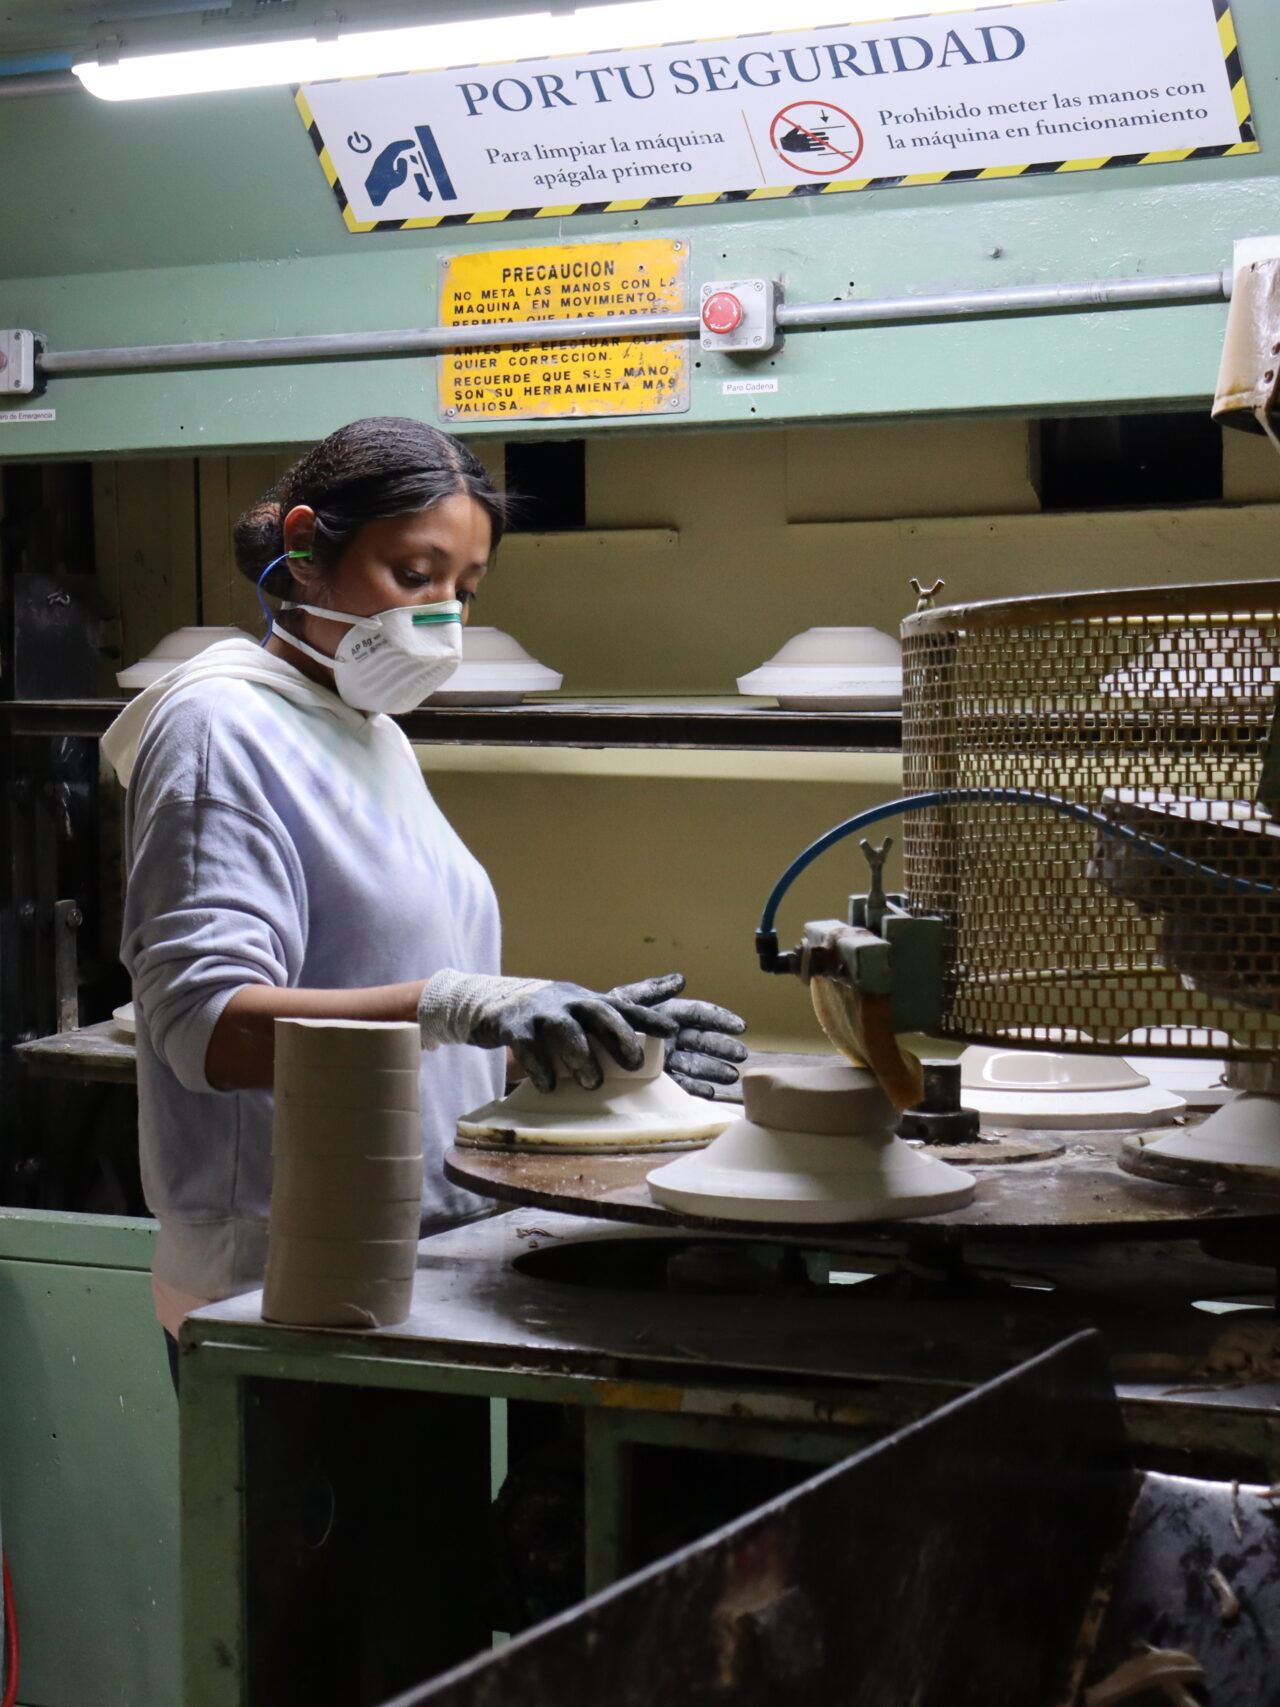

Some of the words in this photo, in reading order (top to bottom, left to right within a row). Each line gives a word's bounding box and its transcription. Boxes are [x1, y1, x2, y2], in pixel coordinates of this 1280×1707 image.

[455, 74, 578, 117] POR
[575, 63, 655, 104] TU
[668, 24, 1026, 95] SEGURIDAD
[878, 101, 982, 127] Prohibido
[987, 97, 1049, 117] meter
[1052, 91, 1083, 110] las
[1087, 87, 1160, 106] manos
[1165, 80, 1206, 98] con
[887, 133, 907, 150] la
[911, 124, 1001, 151] máquina
[1006, 124, 1030, 139] en
[1035, 105, 1208, 136] funcionamiento
[485, 146, 533, 165] Para
[536, 137, 607, 163] limpiar
[610, 136, 630, 153] la
[635, 127, 725, 153] máquina
[533, 163, 607, 190] apágala
[612, 158, 693, 183] primero
[502, 260, 614, 283] PRECAUCION
[454, 291, 472, 301] NO
[481, 288, 516, 299] META
[525, 285, 551, 296] LAS
[561, 281, 611, 294] MANOS
[621, 278, 650, 290] CON
[454, 301, 520, 315] MAQUINA
[532, 299, 550, 309] EN
[454, 344, 501, 356] ANTES
[512, 342, 530, 352] DE
[454, 358, 497, 370] QUIER
[454, 373, 531, 387] RECUERDE
[543, 371, 571, 382] QUE
[726, 384, 744, 392] Paro
[745, 382, 774, 391] Cadena
[455, 389, 484, 401] SON
[495, 387, 513, 398] SU
[524, 381, 630, 396] HERRAMIENTA
